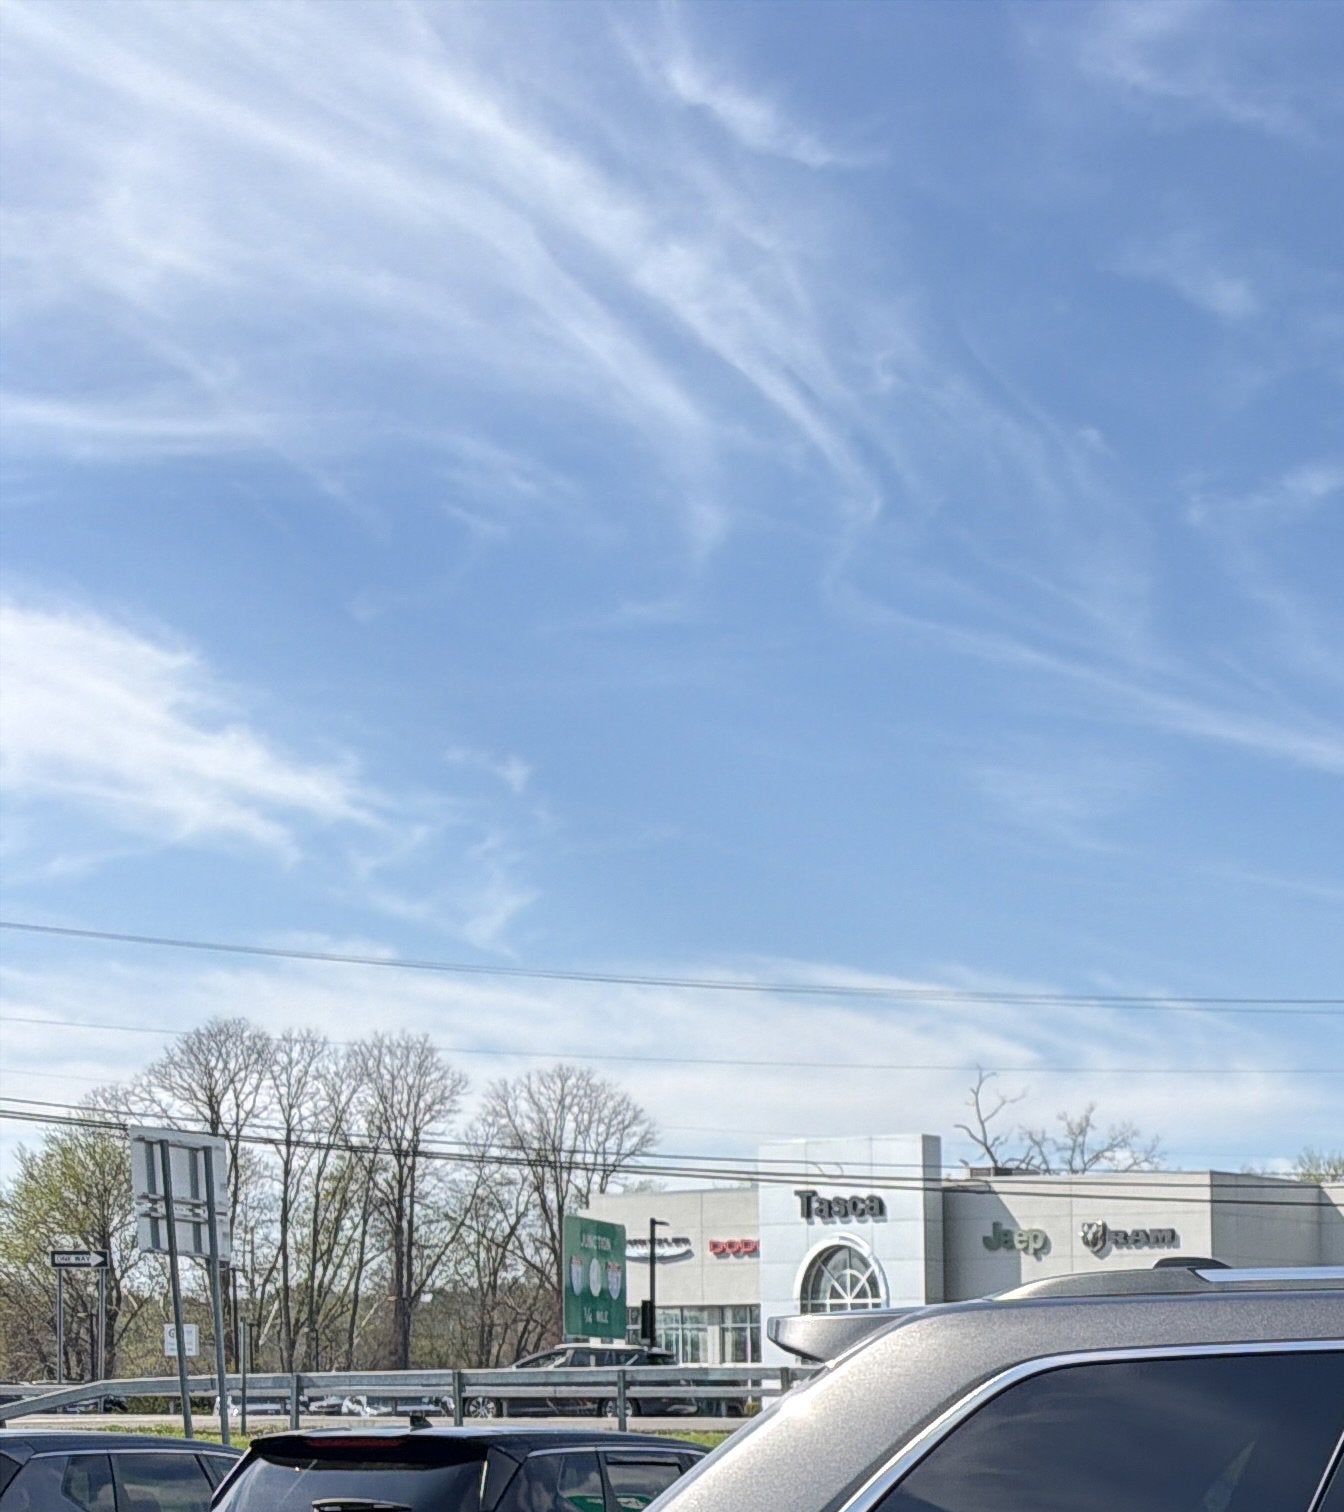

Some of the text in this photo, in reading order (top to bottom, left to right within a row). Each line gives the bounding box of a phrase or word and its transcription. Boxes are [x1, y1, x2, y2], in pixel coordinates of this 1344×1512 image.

[794, 1190, 886, 1220] Tasca
[982, 1221, 1047, 1256] Jeep
[1108, 1228, 1176, 1246] RAM
